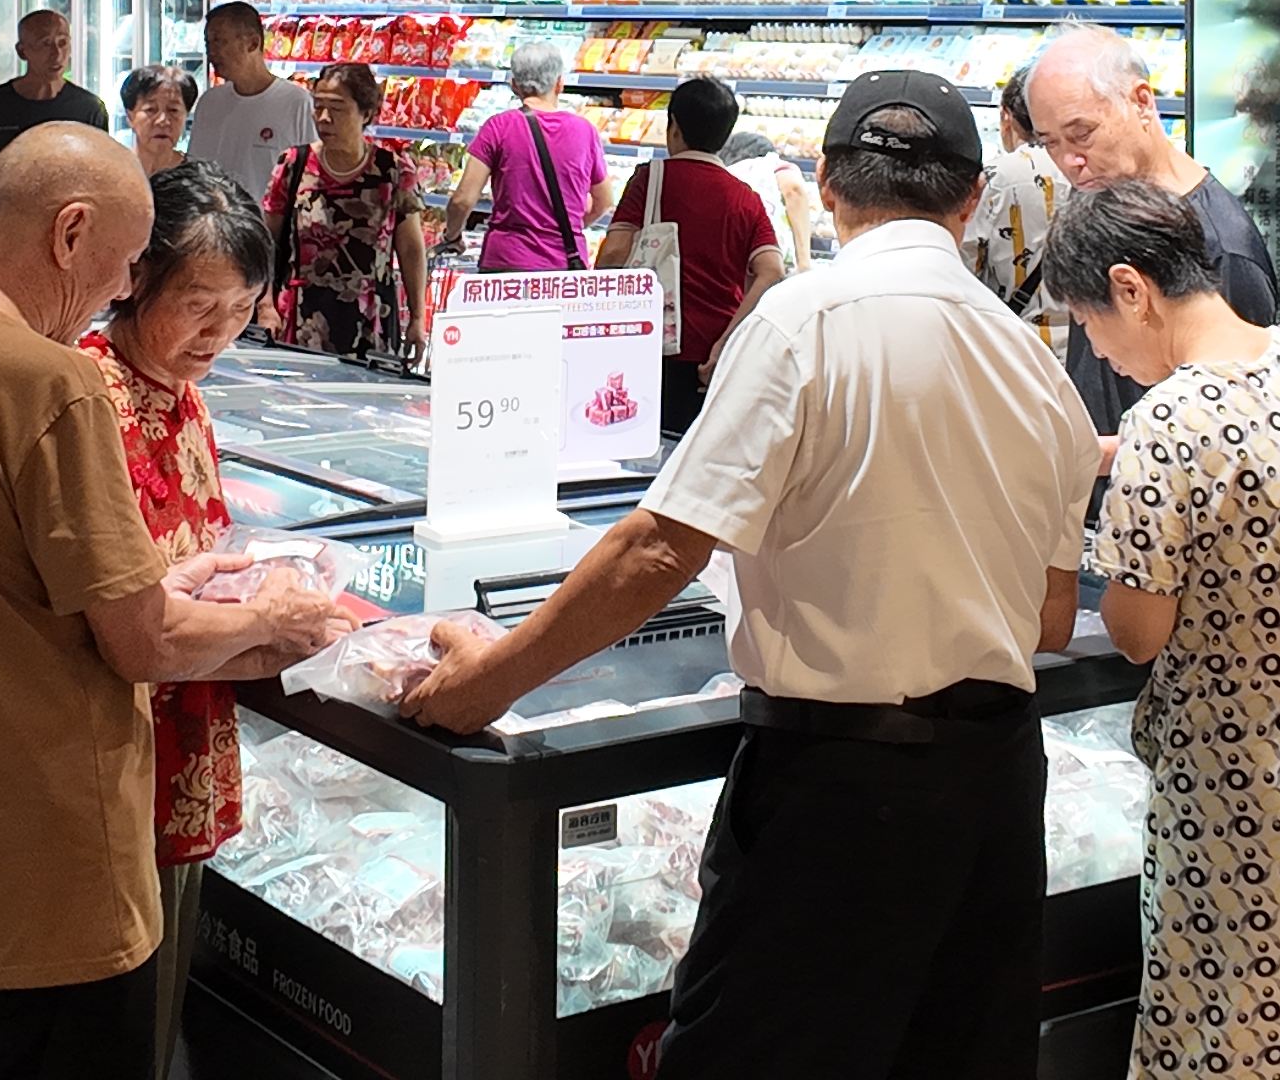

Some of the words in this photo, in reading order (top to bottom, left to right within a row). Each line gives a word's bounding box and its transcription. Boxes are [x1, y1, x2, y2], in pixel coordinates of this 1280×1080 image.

[463, 273, 654, 304] 原切安格斯谷饲牛腩块
[272, 968, 318, 1015] FROZEN
[318, 997, 352, 1036] FOOD
